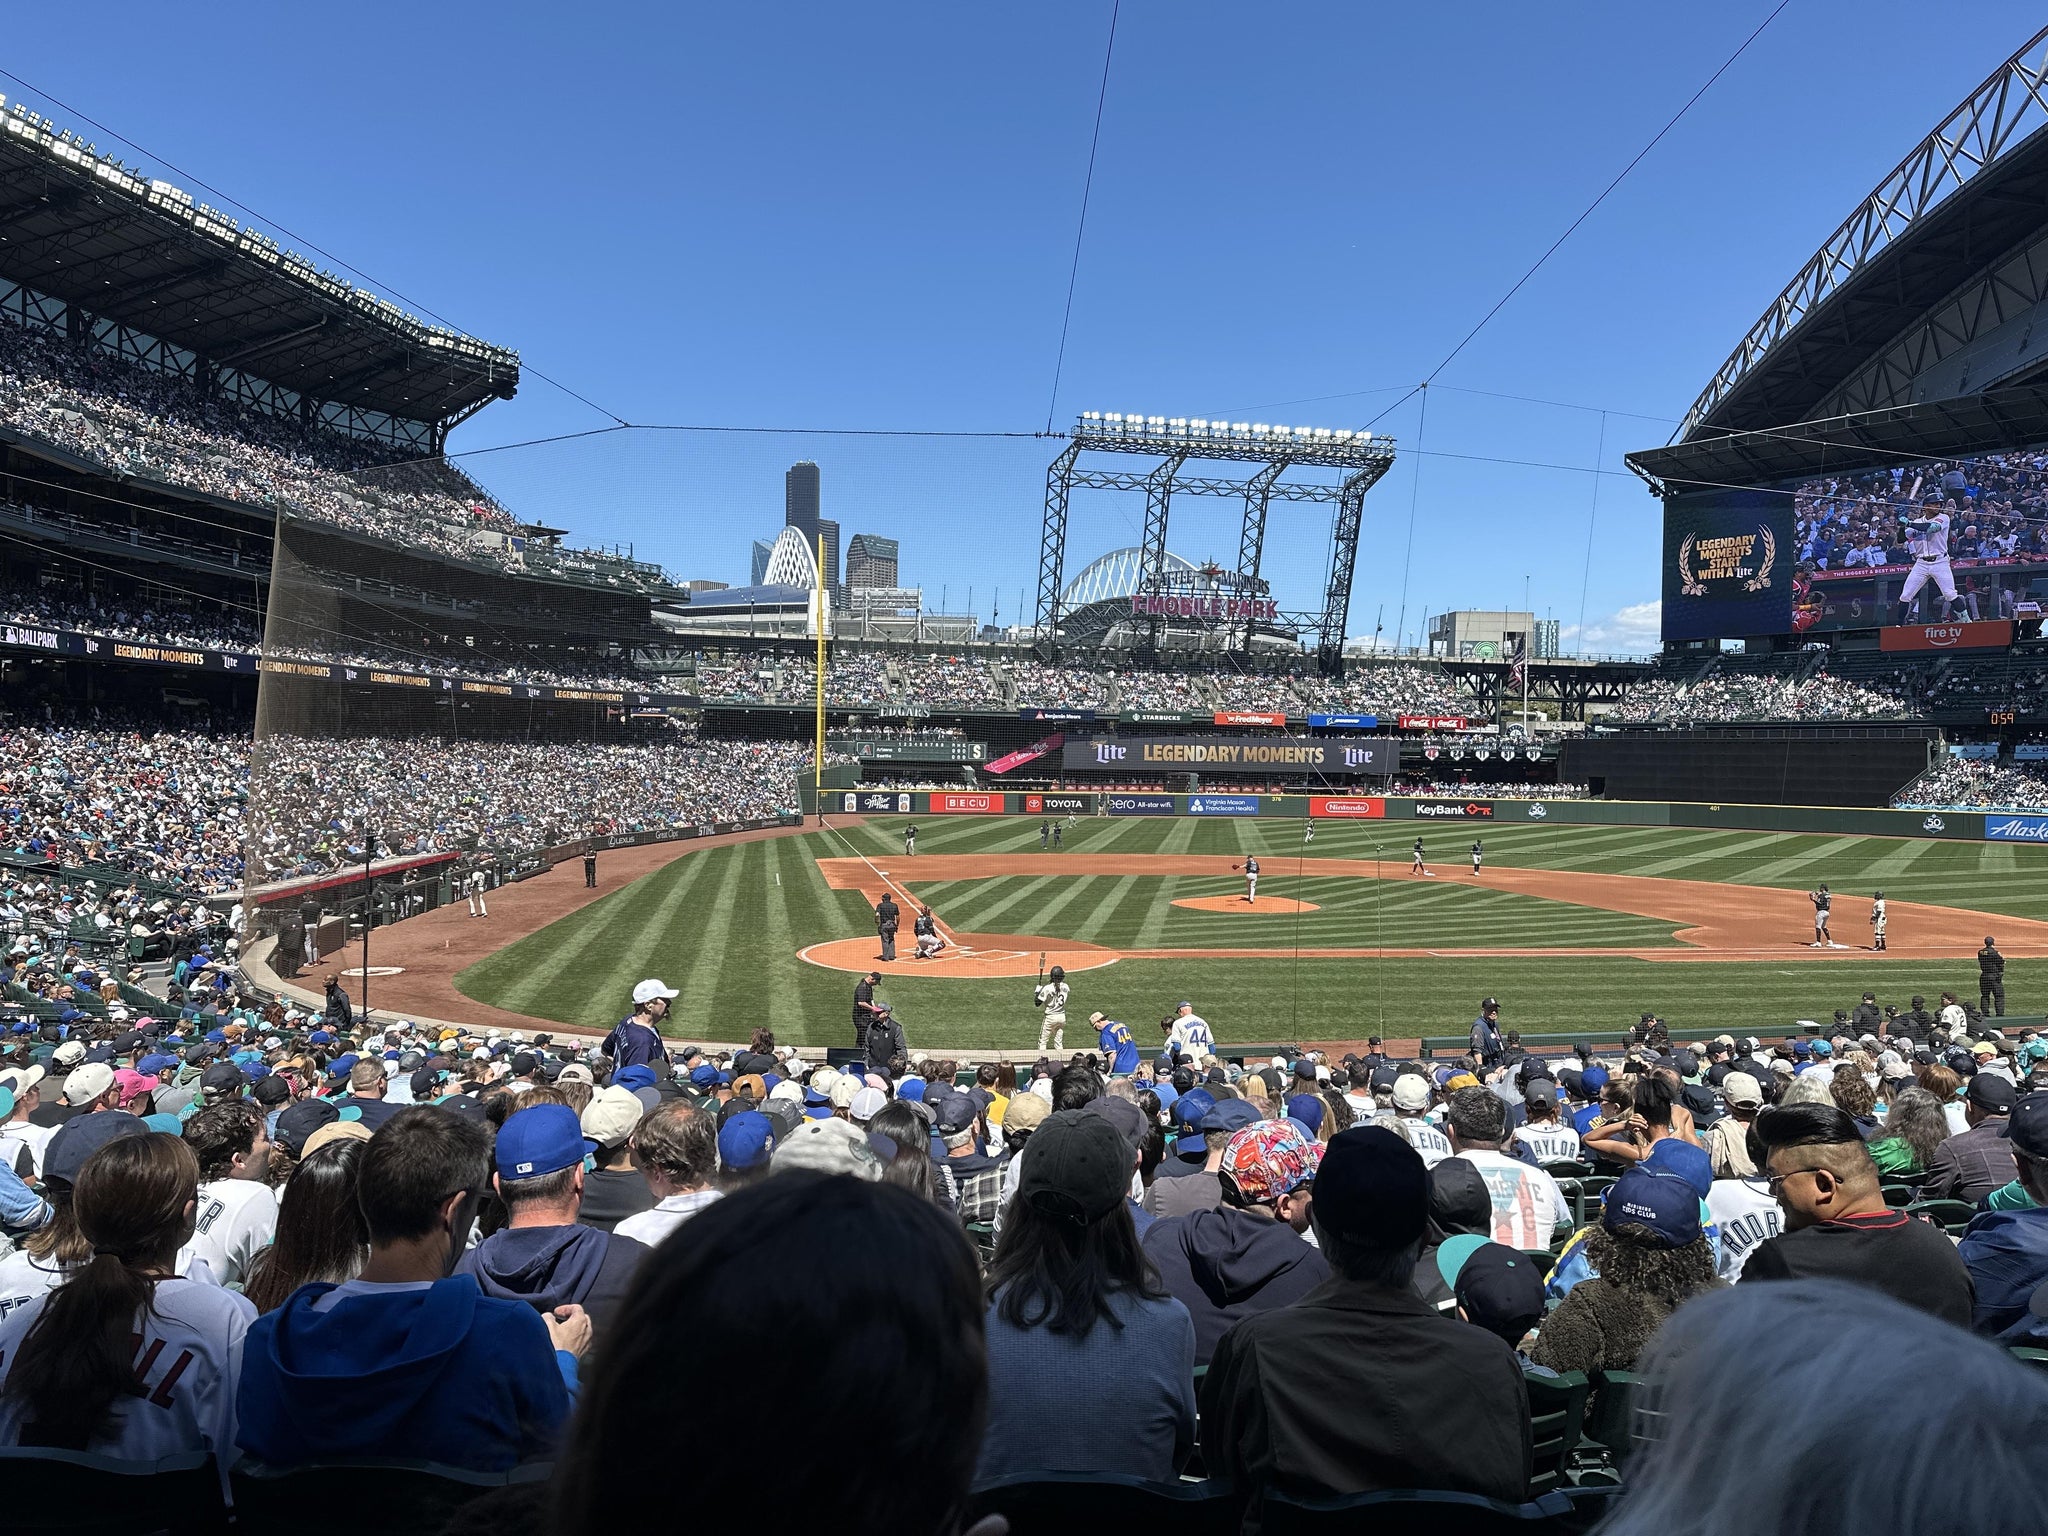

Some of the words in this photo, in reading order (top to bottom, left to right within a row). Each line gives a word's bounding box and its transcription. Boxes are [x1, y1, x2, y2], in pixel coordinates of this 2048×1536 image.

[1696, 534, 1757, 551] LEGENDARY
[1700, 545, 1752, 560] MOMENTS
[1709, 556, 1742, 569] START
[1146, 570, 1194, 589] SEATTLE
[1698, 568, 1724, 580] WITH
[1725, 568, 1734, 578] A
[1736, 567, 1753, 578] Lite
[1220, 570, 1270, 595] MARINERS
[1131, 594, 1222, 617] T-MOBILE
[1227, 599, 1279, 619] PARK
[18, 628, 59, 650] BALLPARK
[1924, 627, 1947, 639] fire
[1949, 627, 1962, 638] tv
[85, 638, 99, 653] Lite
[114, 643, 160, 661] LEGENDARY
[160, 649, 204, 665] MOMENTS
[222, 654, 238, 669] Lite
[255, 659, 297, 675] LEGENDARY
[297, 665, 331, 678] MOMENTS
[370, 671, 404, 684] LEGENDARY
[403, 675, 431, 688] MOMENTS
[462, 682, 490, 693] LEGENDARY
[489, 685, 512, 695] MOMENTS
[554, 689, 592, 700] LEGENDARY
[592, 692, 624, 702] MOMENTS
[1991, 713, 2014, 725] 0:59
[1095, 743, 1127, 764] Lite
[1143, 744, 1240, 762] LEGENDARY
[1242, 746, 1325, 764] MOMENTS
[1344, 748, 1374, 768] Lite
[1045, 799, 1083, 808] TOYOTA
[1109, 799, 1135, 809] eero
[1329, 803, 1365, 811] Nintendo
[1416, 804, 1465, 816] KeyBank
[1927, 818, 1941, 827] 50
[698, 825, 716, 836] STIHL
[615, 836, 635, 845] LEXUS
[1117, 1028, 1133, 1044] 44
[1190, 1029, 1207, 1047] 44
[1637, 1210, 1657, 1219] CLUB
[1721, 1209, 1782, 1258] RODR
